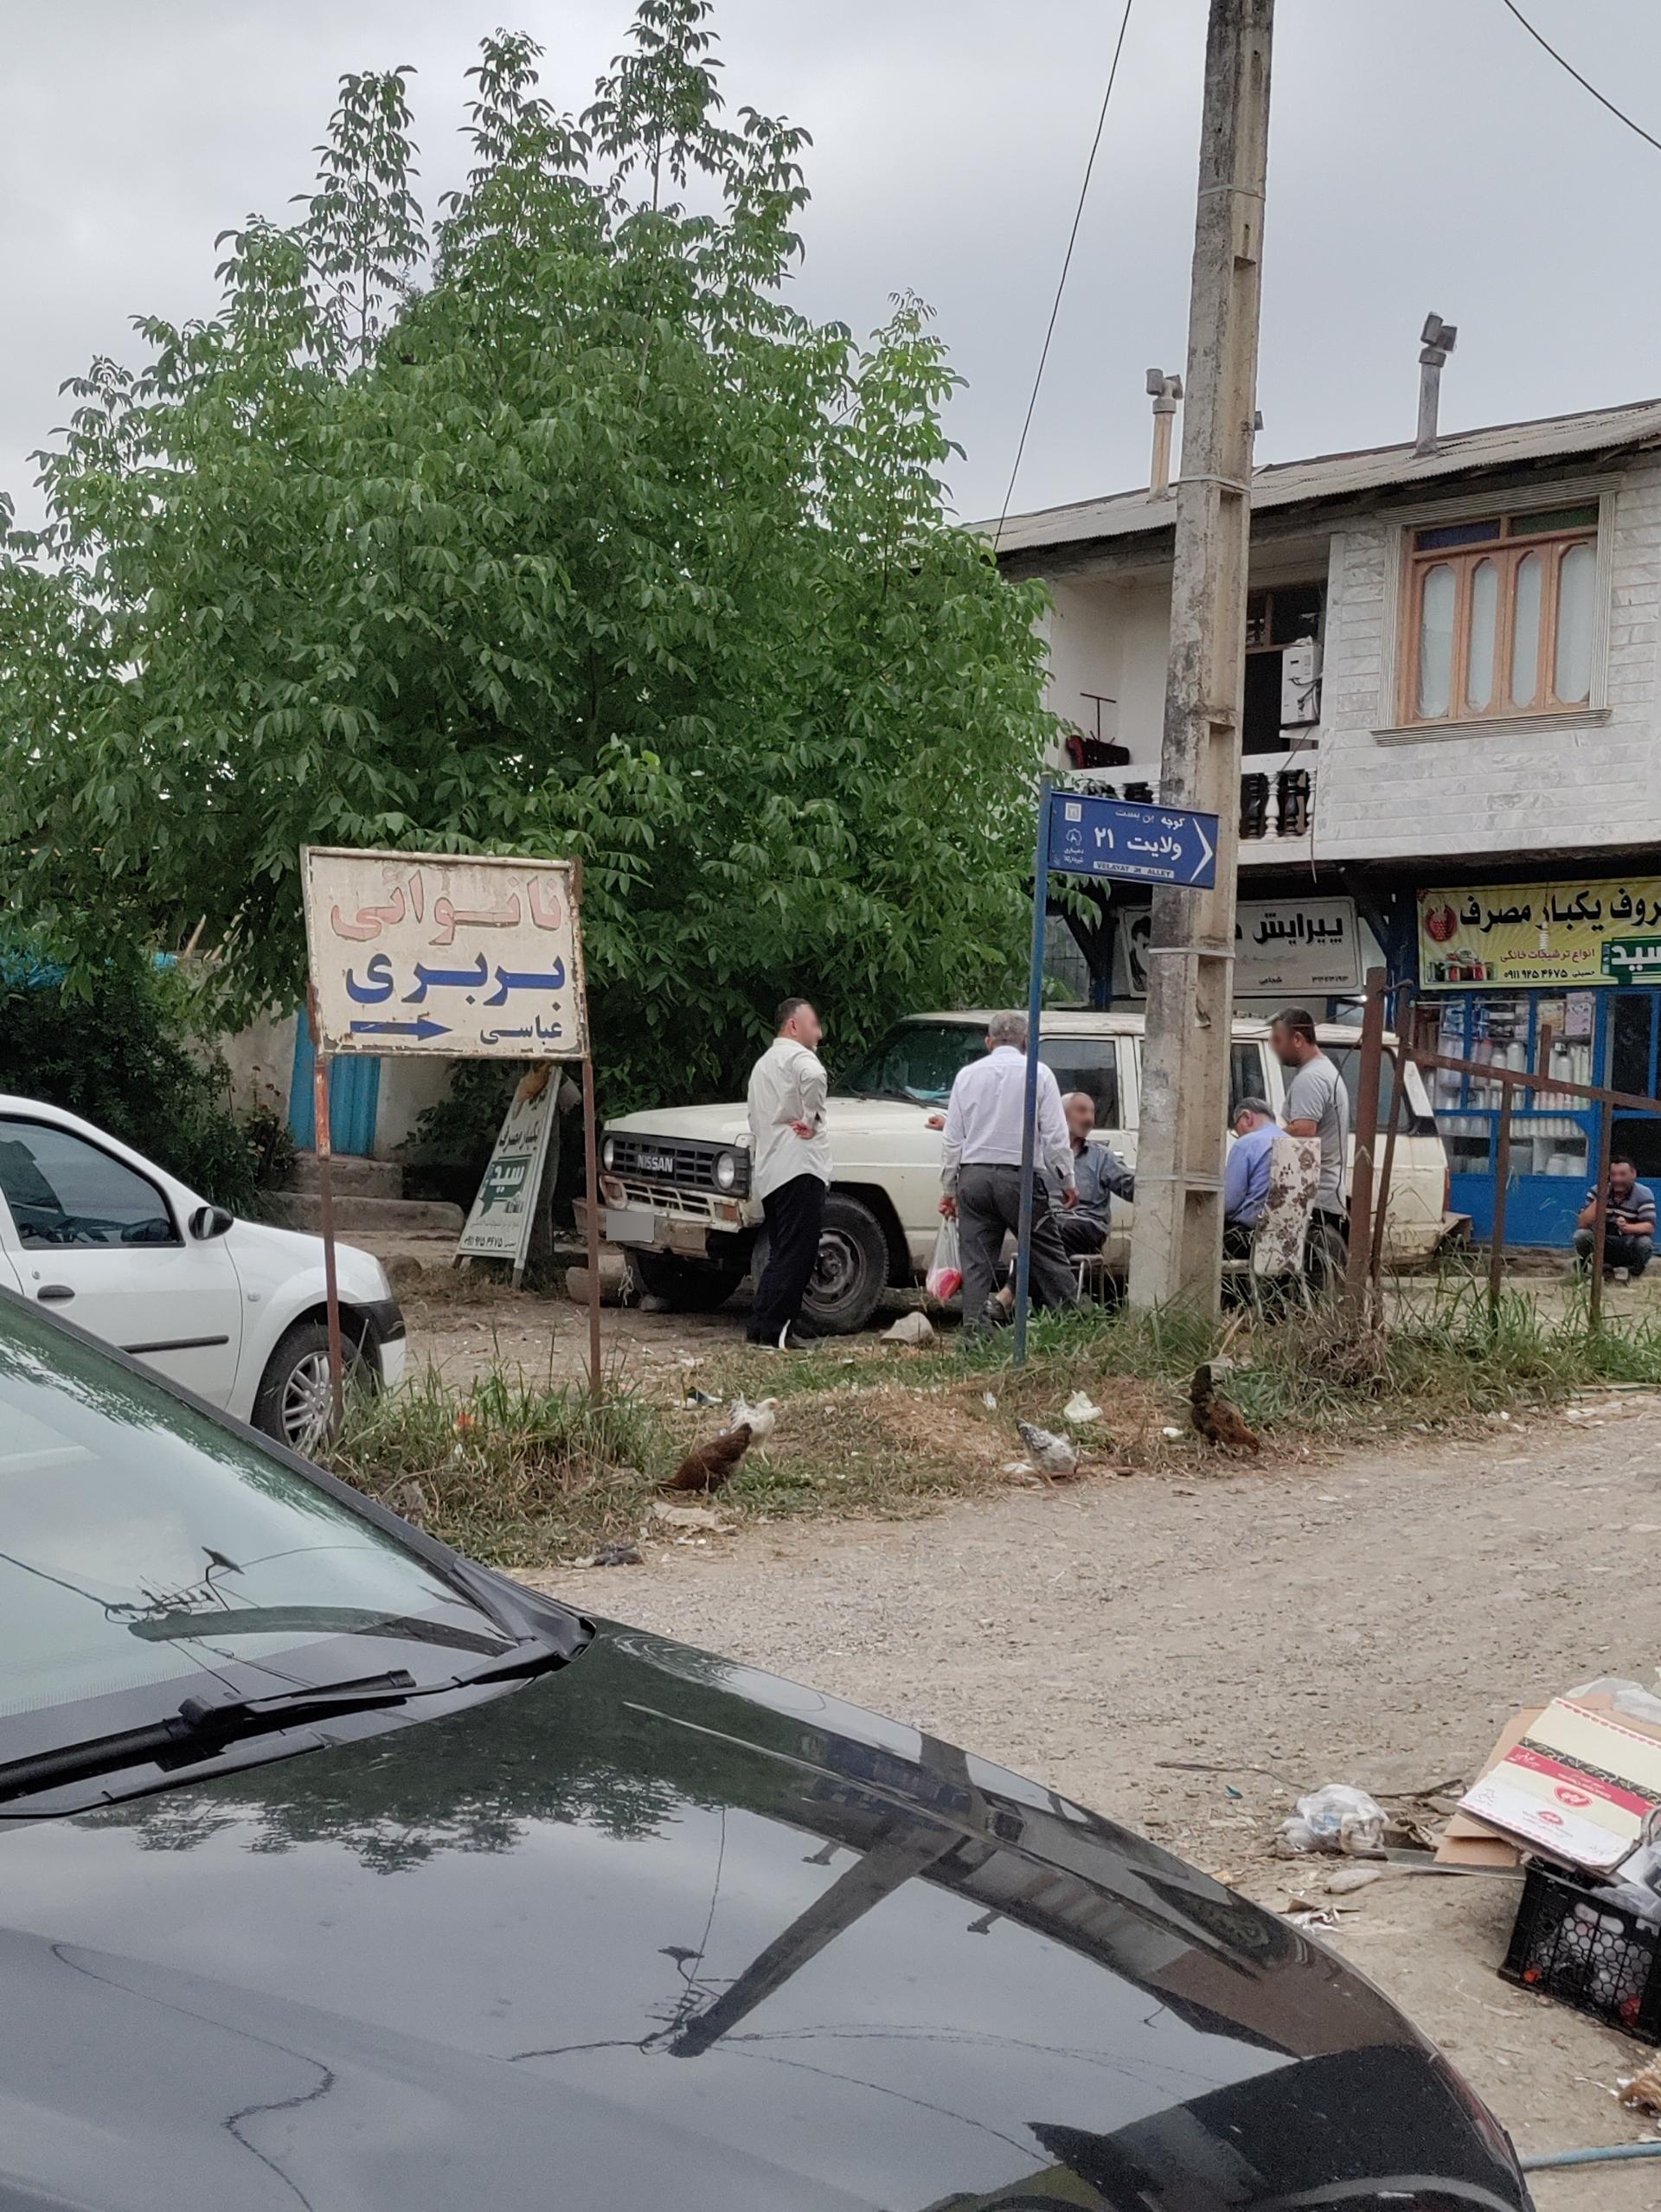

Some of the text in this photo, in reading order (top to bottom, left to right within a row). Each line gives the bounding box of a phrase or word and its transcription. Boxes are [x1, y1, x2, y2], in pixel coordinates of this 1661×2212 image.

[1160, 816, 1185, 830] کوچه
[1093, 826, 1183, 861] ولایت ۲۱
[1097, 862, 1130, 874] VELAYAT
[1147, 869, 1171, 878] ALLEY
[1459, 894, 1530, 933] مصرف
[1535, 890, 1605, 932] یکبار
[1253, 913, 1344, 946] پیرایش
[1500, 950, 1526, 963] خانگی
[1572, 948, 1594, 963] انواع
[345, 952, 565, 1011] بربری
[479, 1014, 562, 1045] عباسی
[637, 1153, 673, 1173] NISSAN
